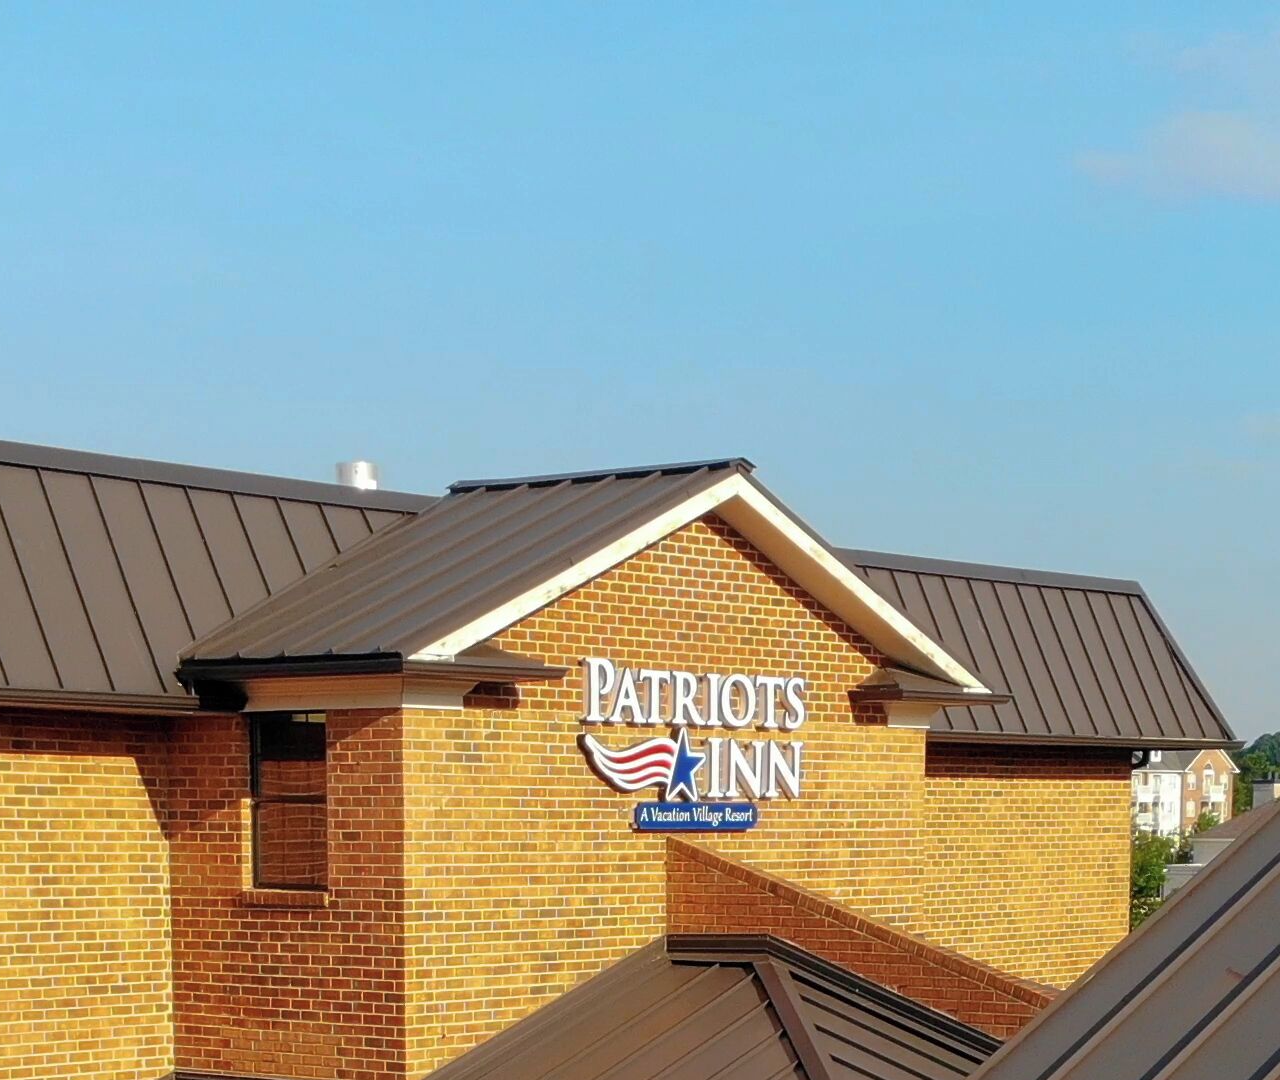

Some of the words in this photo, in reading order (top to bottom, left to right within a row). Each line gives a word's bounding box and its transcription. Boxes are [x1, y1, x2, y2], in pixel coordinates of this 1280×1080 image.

[583, 656, 807, 729] PATRIOTS
[705, 737, 805, 799] INN
[640, 807, 649, 822] A
[650, 806, 691, 822] Vacation
[692, 805, 724, 827] Village
[725, 807, 753, 822] Resort
